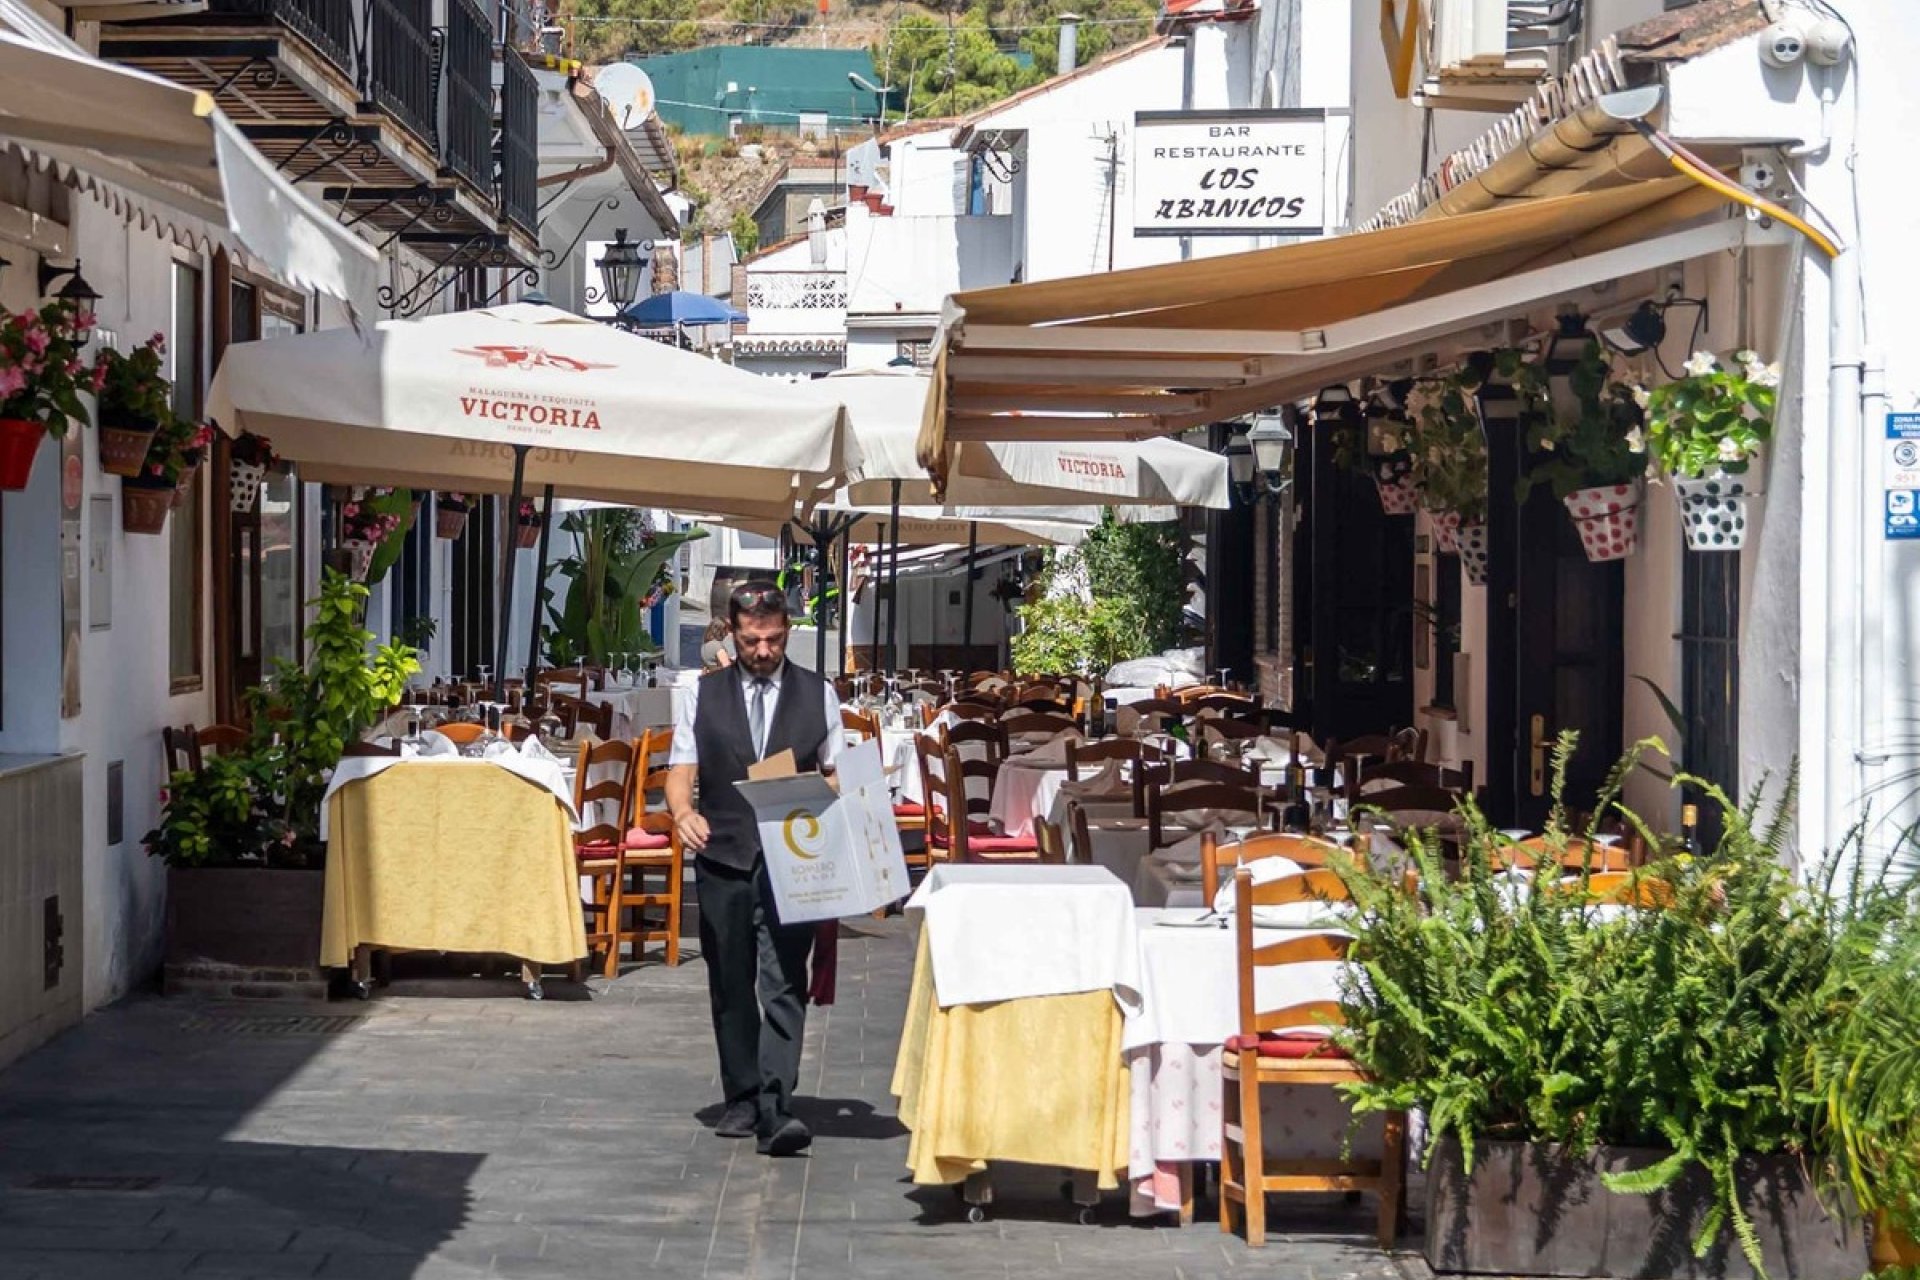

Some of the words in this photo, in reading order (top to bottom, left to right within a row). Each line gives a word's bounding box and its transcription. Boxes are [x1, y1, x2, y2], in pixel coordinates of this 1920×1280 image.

[1209, 126, 1251, 137] BAR
[1154, 145, 1306, 158] RESTAURANTE
[1200, 168, 1259, 189] LOS
[1154, 197, 1305, 219] ABANICOS
[460, 397, 602, 430] VICTORIA
[1058, 457, 1125, 478] VICTORIA
